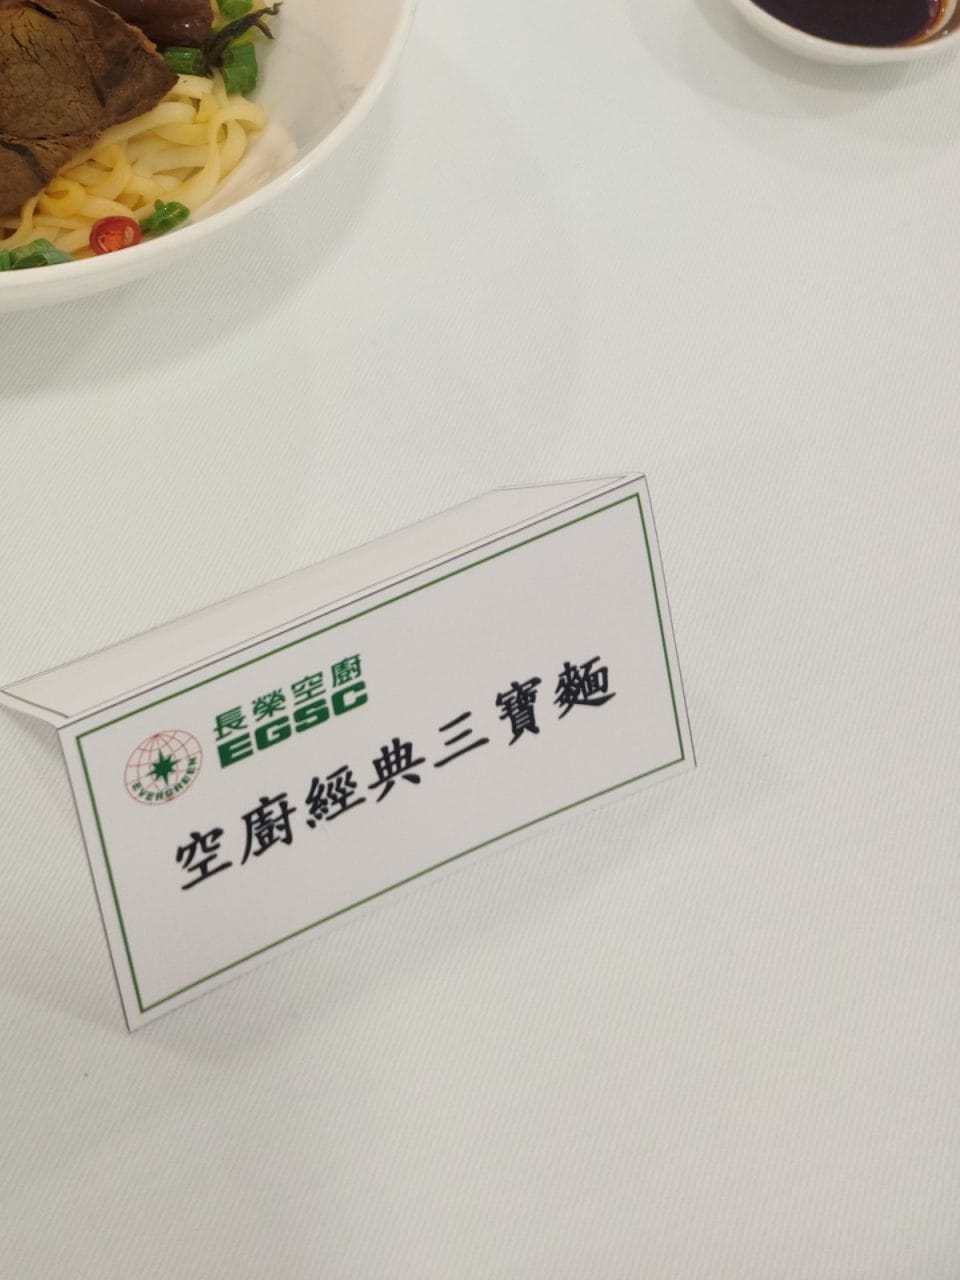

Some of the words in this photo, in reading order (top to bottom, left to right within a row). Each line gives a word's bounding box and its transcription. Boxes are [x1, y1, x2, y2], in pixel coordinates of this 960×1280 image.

[213, 653, 362, 742] 長榮空廚
[216, 680, 369, 769] EGSC
[132, 756, 197, 801] EVERGREEN
[175, 655, 617, 891] 空廚經典三寶麵
